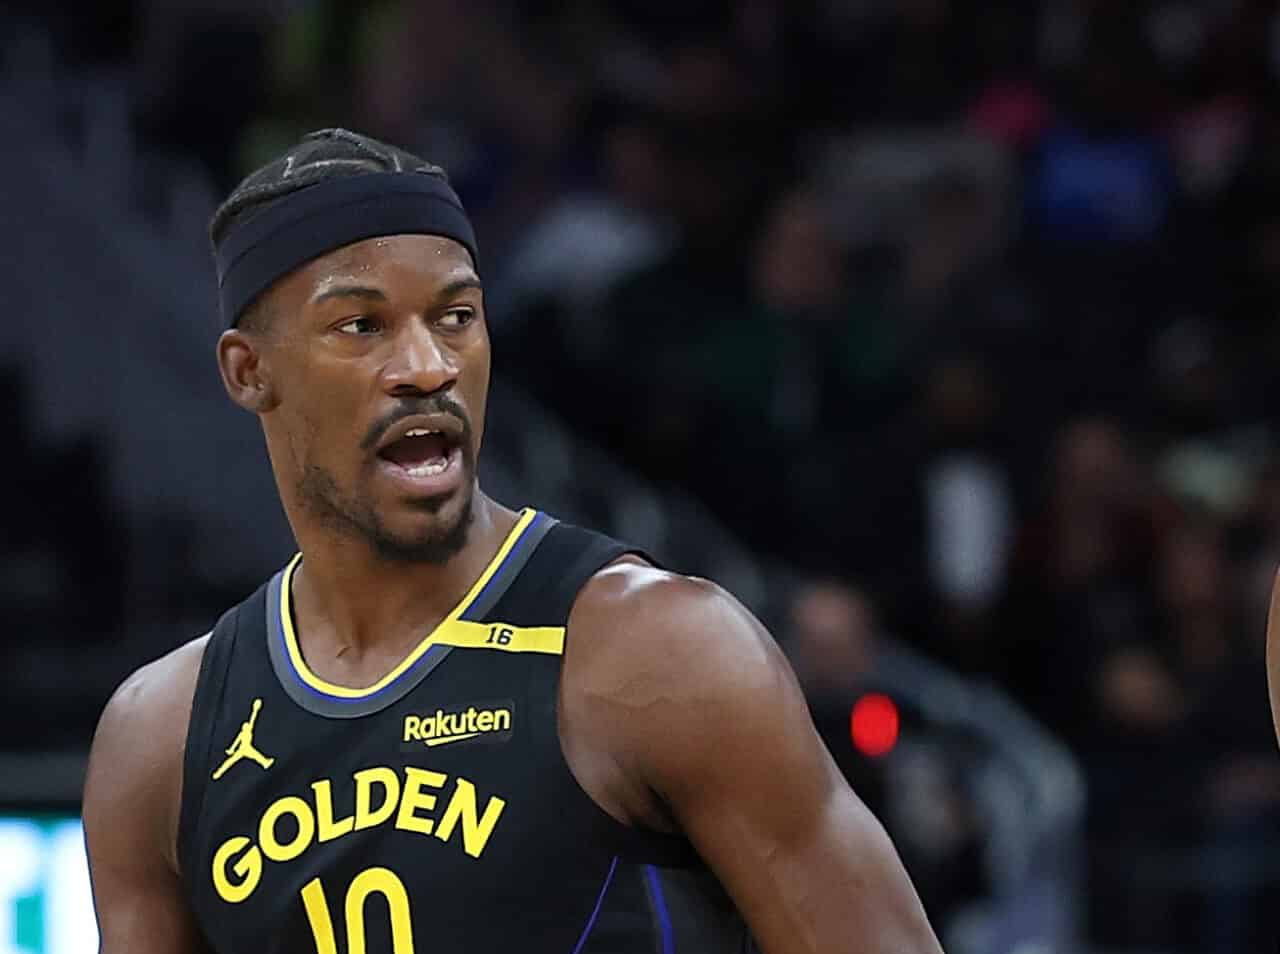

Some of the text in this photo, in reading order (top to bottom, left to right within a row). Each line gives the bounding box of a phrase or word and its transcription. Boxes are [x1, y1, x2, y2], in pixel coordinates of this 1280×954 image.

[485, 626, 514, 646] 16
[403, 707, 511, 743] Rakuten
[212, 766, 507, 904] GOLDEN
